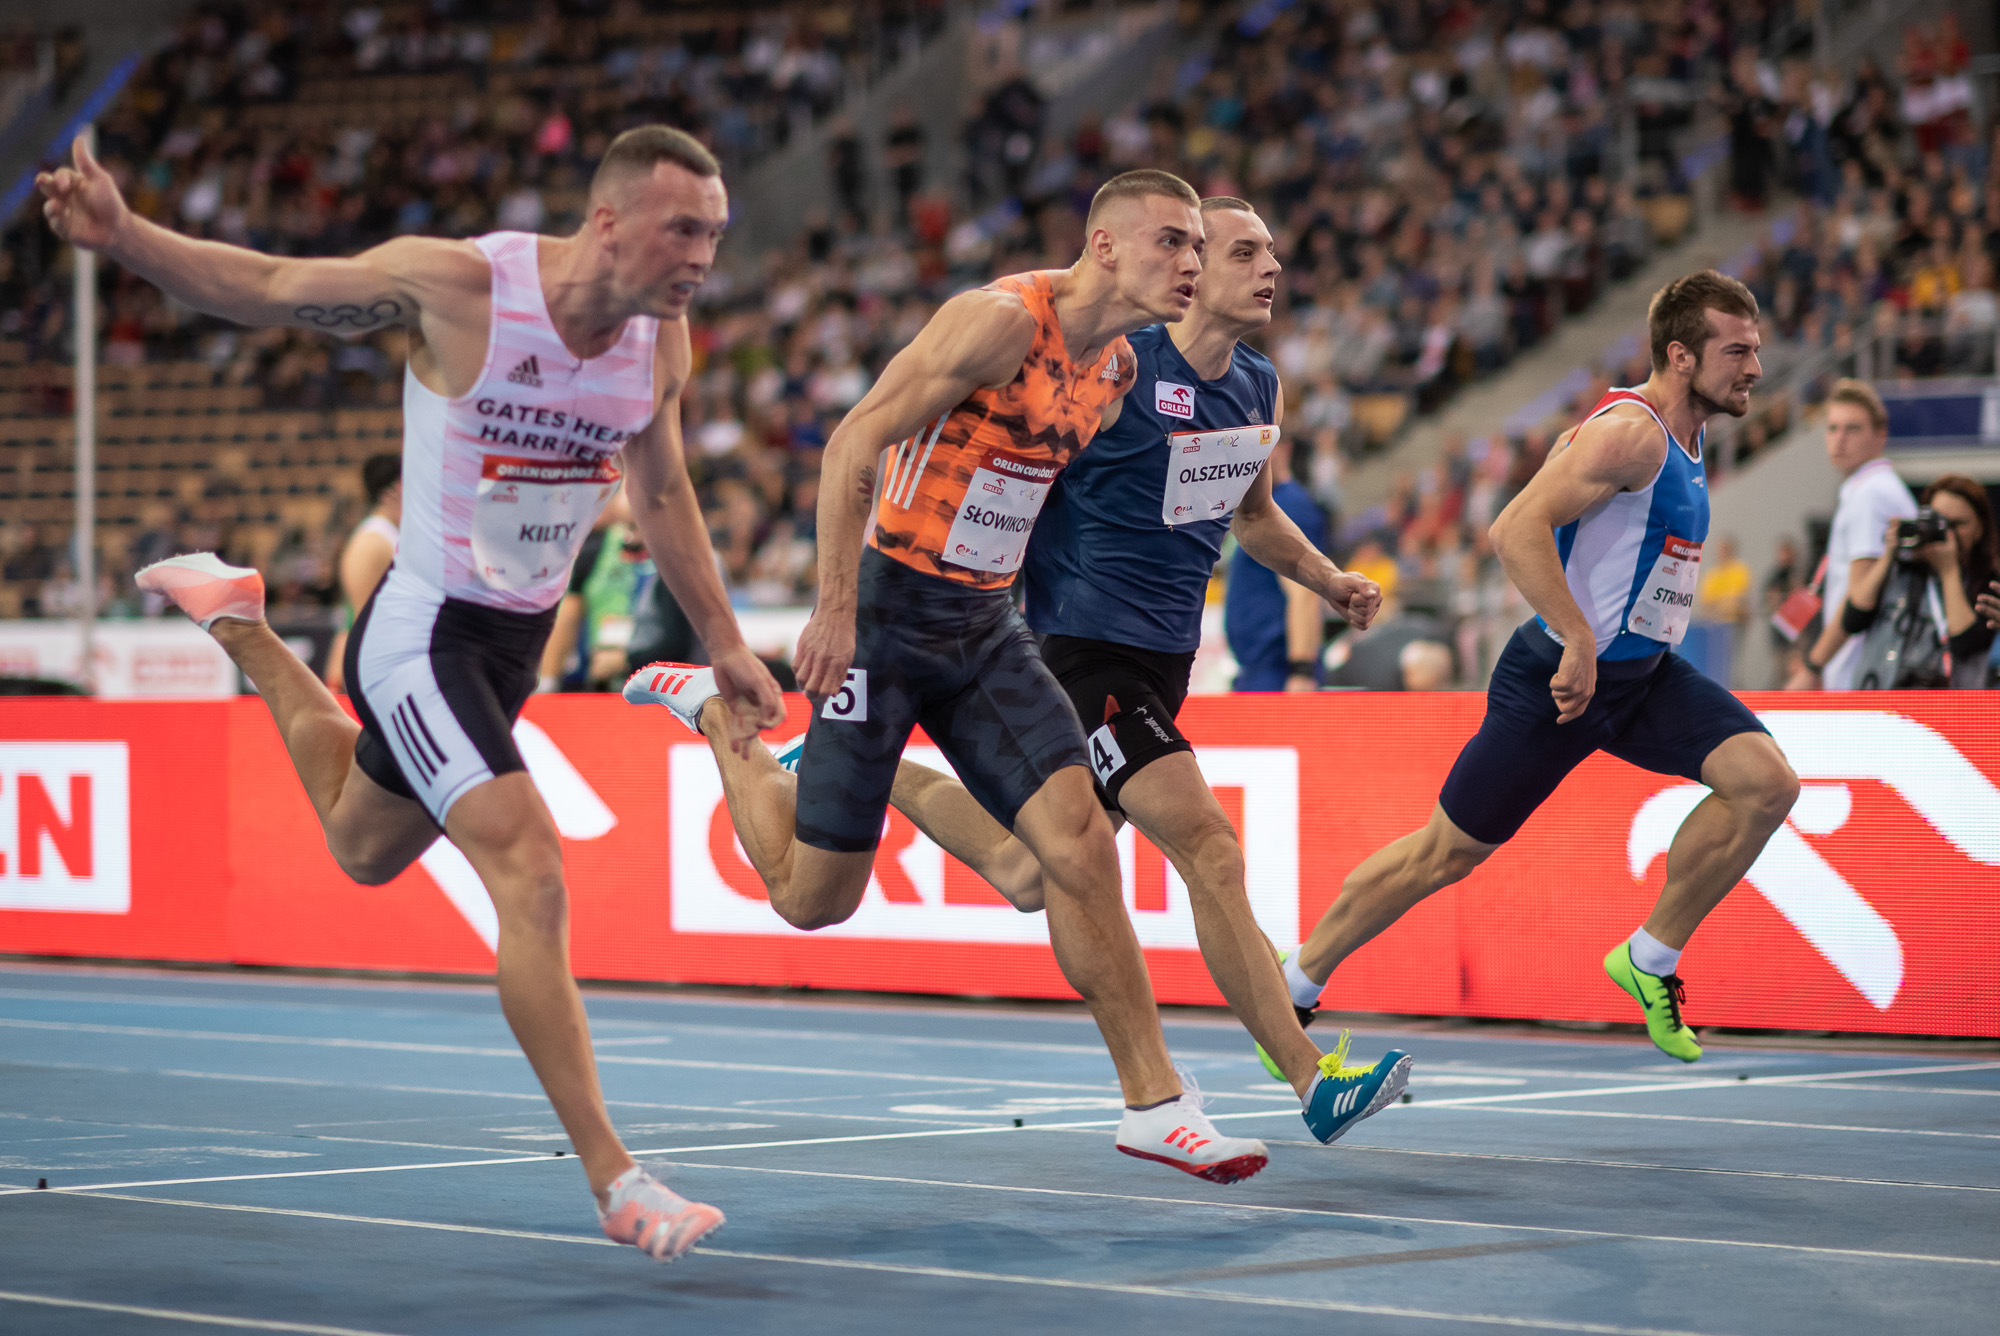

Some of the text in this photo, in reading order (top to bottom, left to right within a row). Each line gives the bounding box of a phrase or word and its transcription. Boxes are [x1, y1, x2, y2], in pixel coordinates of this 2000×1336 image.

[1160, 403, 1189, 415] ORLEN
[496, 464, 540, 479] ORLEN
[993, 457, 1025, 474] ORLEN
[983, 483, 1004, 495] ORLEN
[519, 522, 577, 542] KILTY
[831, 672, 856, 716] 5
[1093, 735, 1115, 774] 4
